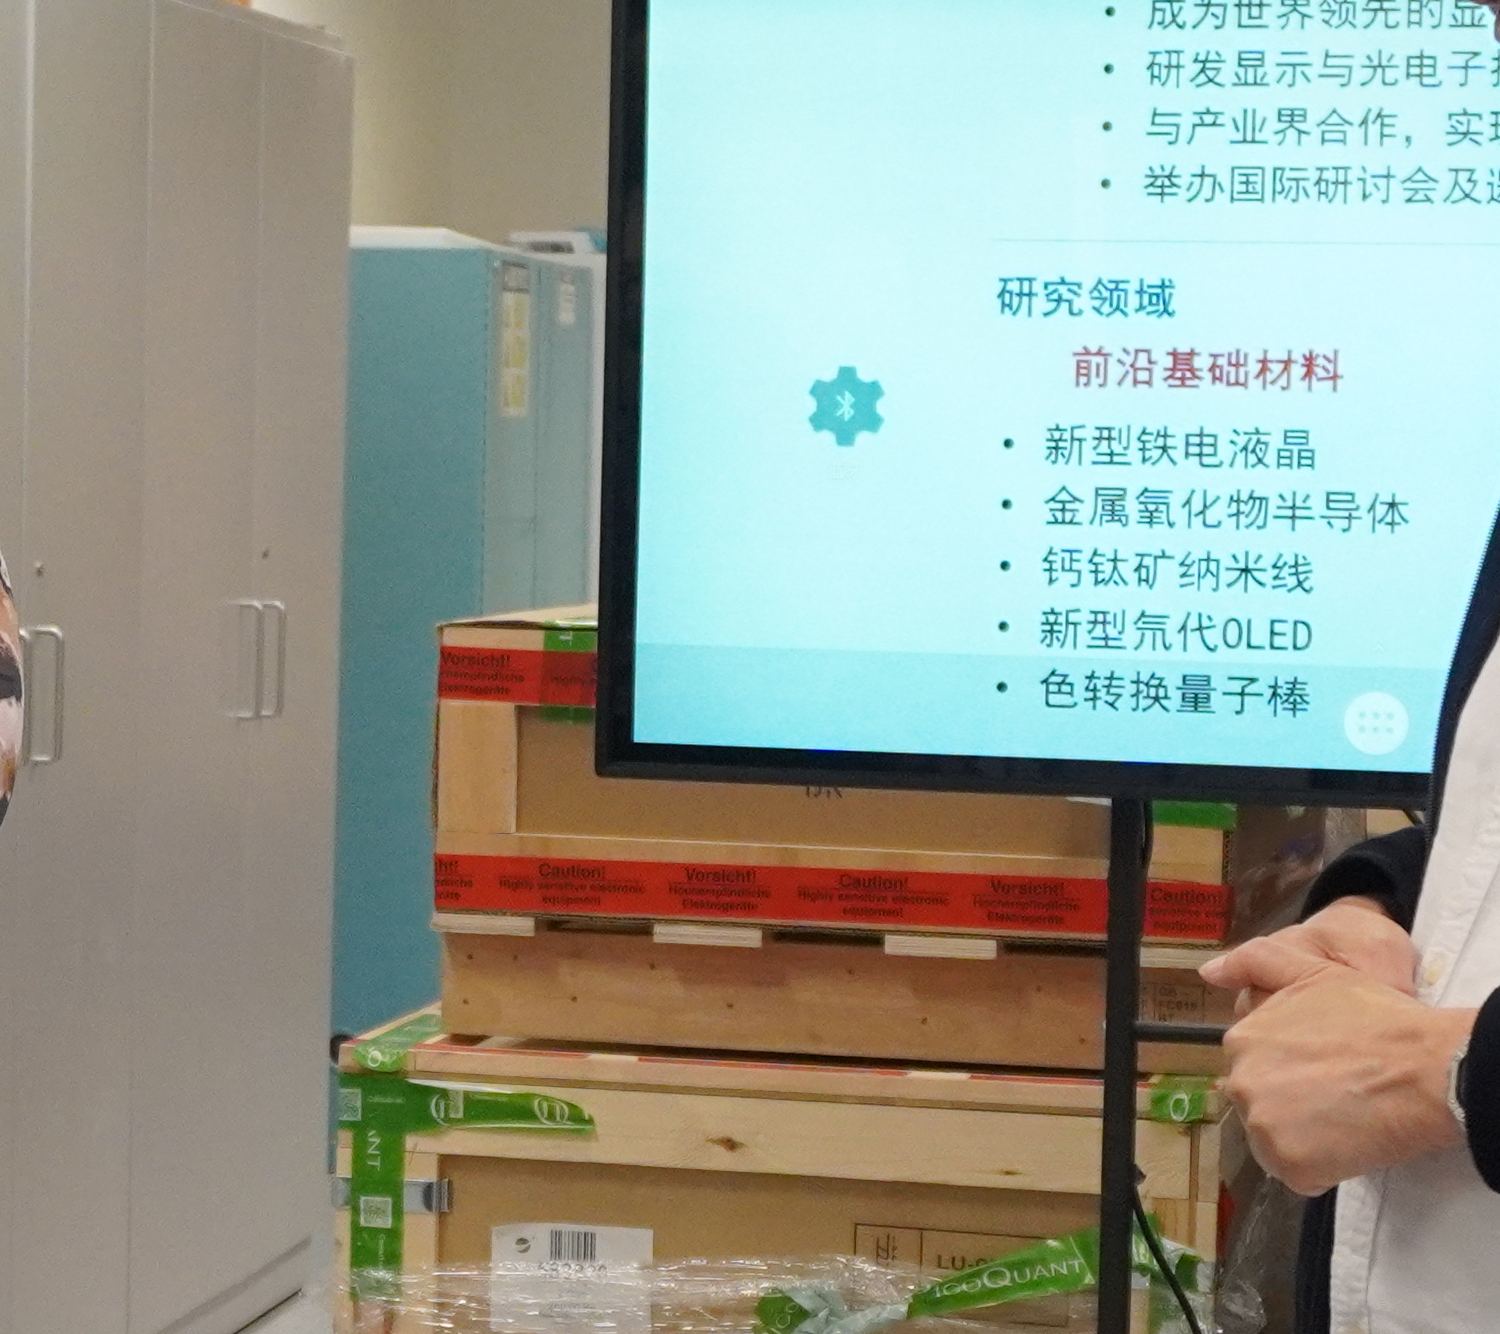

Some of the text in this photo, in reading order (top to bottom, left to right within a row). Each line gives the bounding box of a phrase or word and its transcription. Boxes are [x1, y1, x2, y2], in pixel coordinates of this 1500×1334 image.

[998, 277, 1177, 319] 研究领域
[1072, 345, 1344, 393] 前沿基础材料
[1044, 423, 1316, 471] 新型铁电液晶
[1043, 485, 1410, 535] 金属氧化物半导体
[1042, 546, 1315, 594] 钙钛矿纳米线
[1038, 607, 1314, 653] 新型氘代OLED
[1039, 668, 1311, 719] 色转换量子棒
[538, 862, 606, 880] Caution!
[684, 867, 757, 884] Vorsicht!
[838, 873, 909, 891] Caution!
[990, 878, 1065, 897] Vorsicht!
[1150, 887, 1222, 905] Caution!
